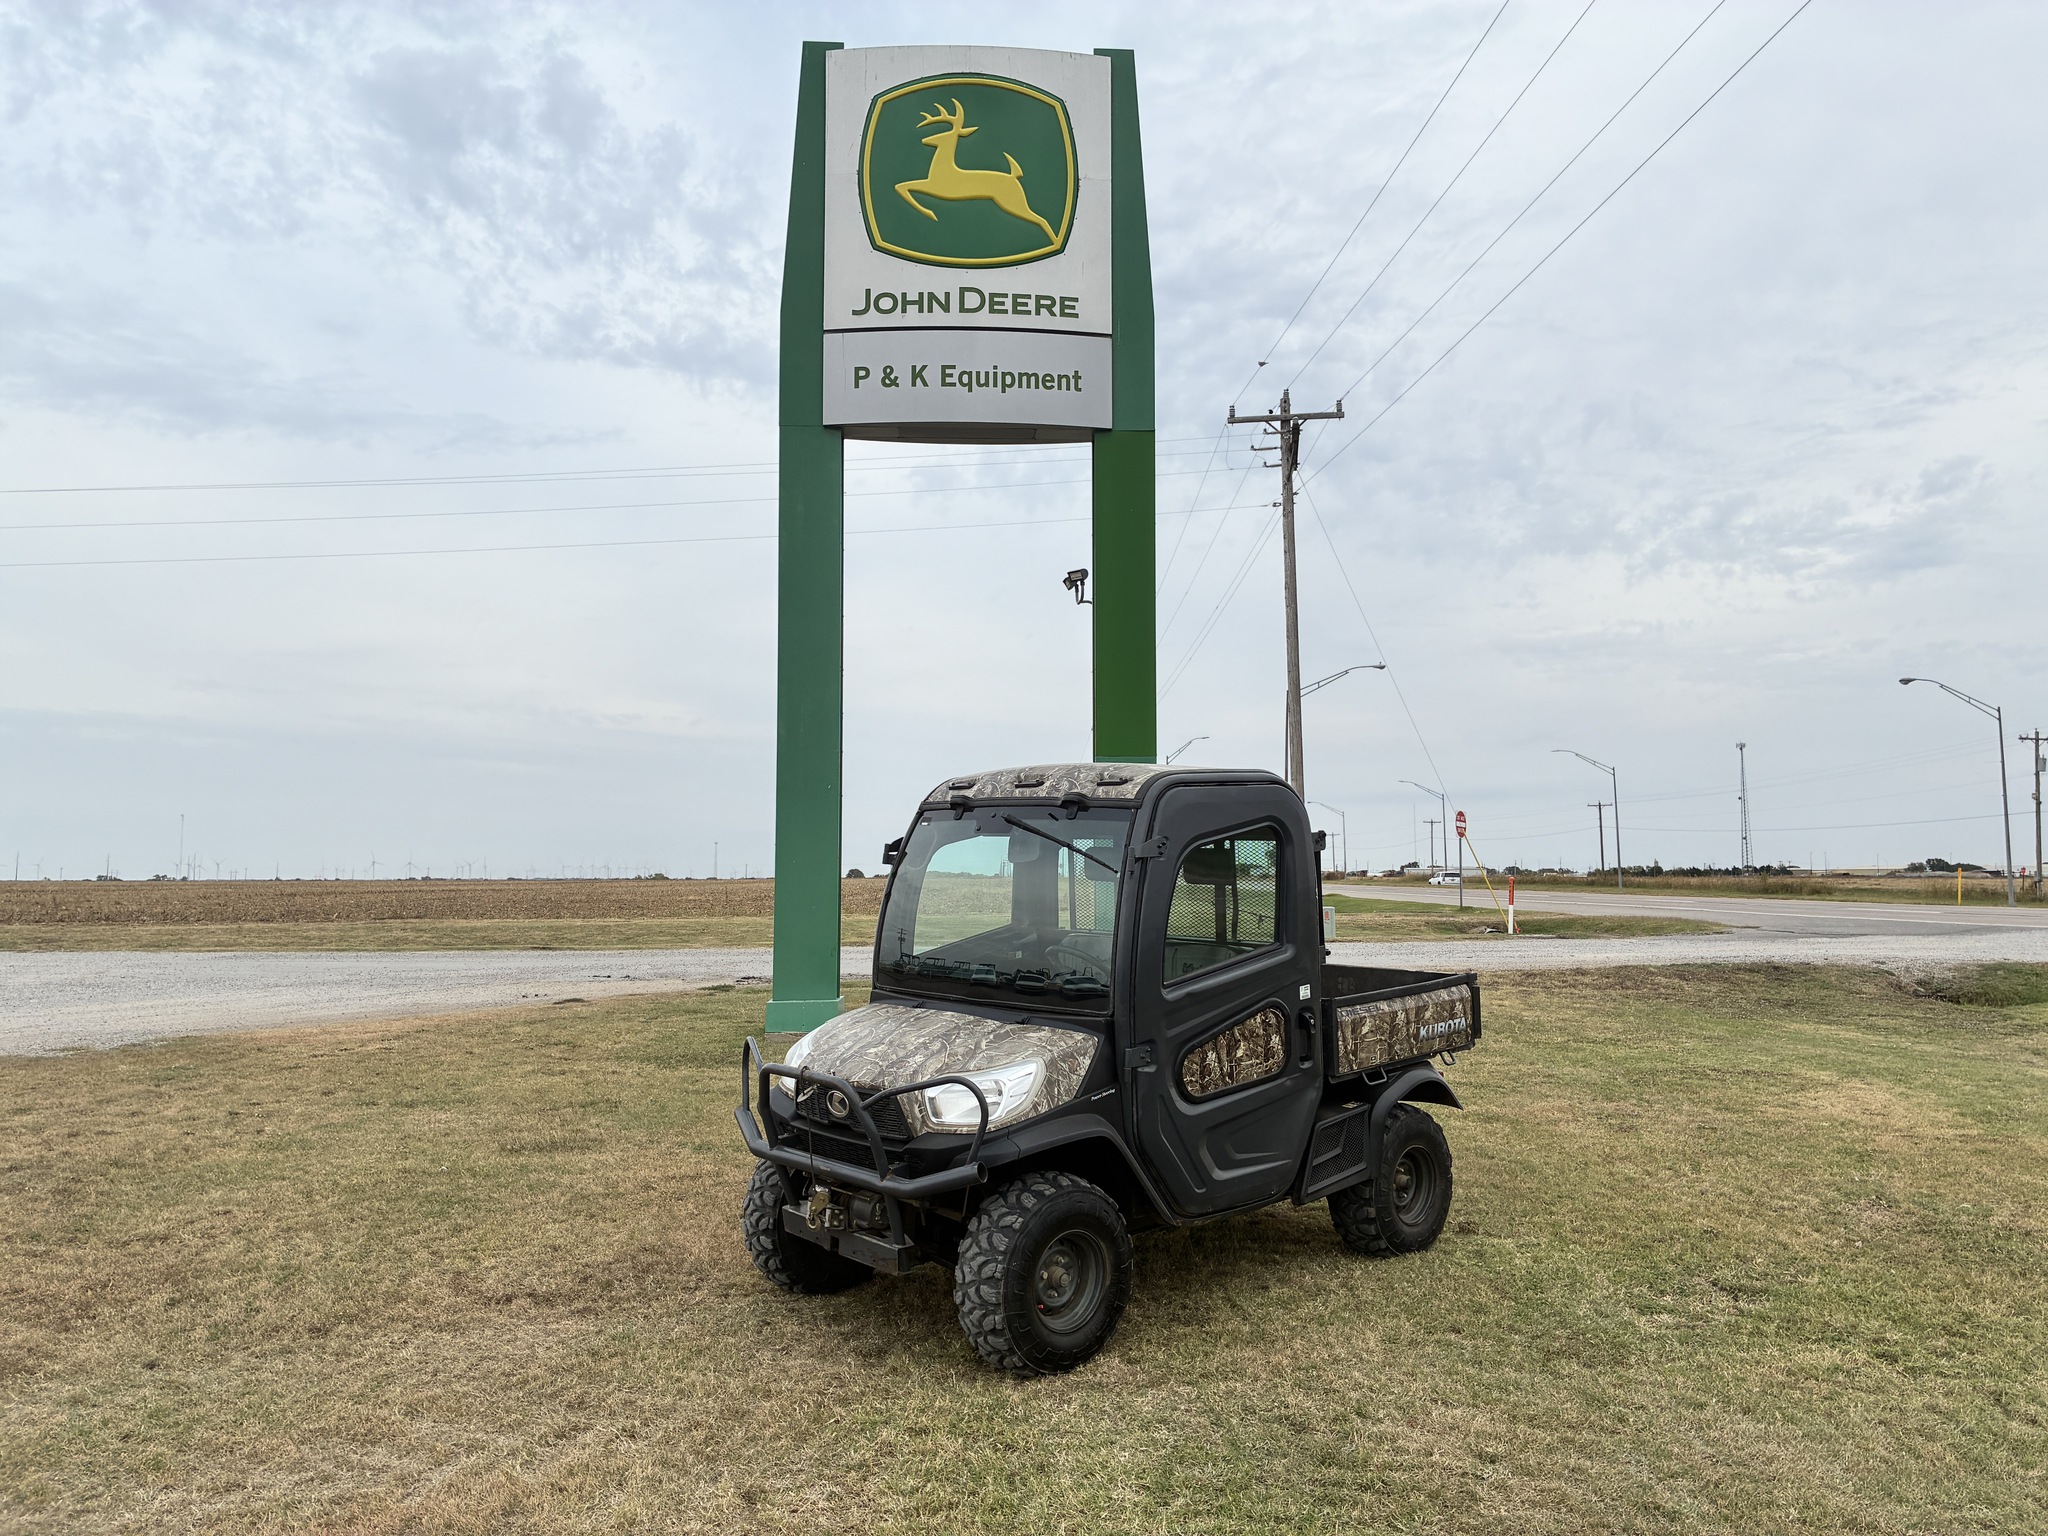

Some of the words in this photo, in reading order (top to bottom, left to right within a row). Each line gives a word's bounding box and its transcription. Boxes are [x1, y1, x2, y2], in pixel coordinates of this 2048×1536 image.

[851, 288, 951, 316] JOHN
[958, 286, 1080, 319] DEERE
[853, 366, 871, 389] P
[880, 365, 900, 388] &
[910, 364, 929, 388] K
[940, 364, 1083, 394] Equipment
[1340, 1003, 1385, 1018] DIESEL
[1420, 1016, 1467, 1041] KUBOTA
